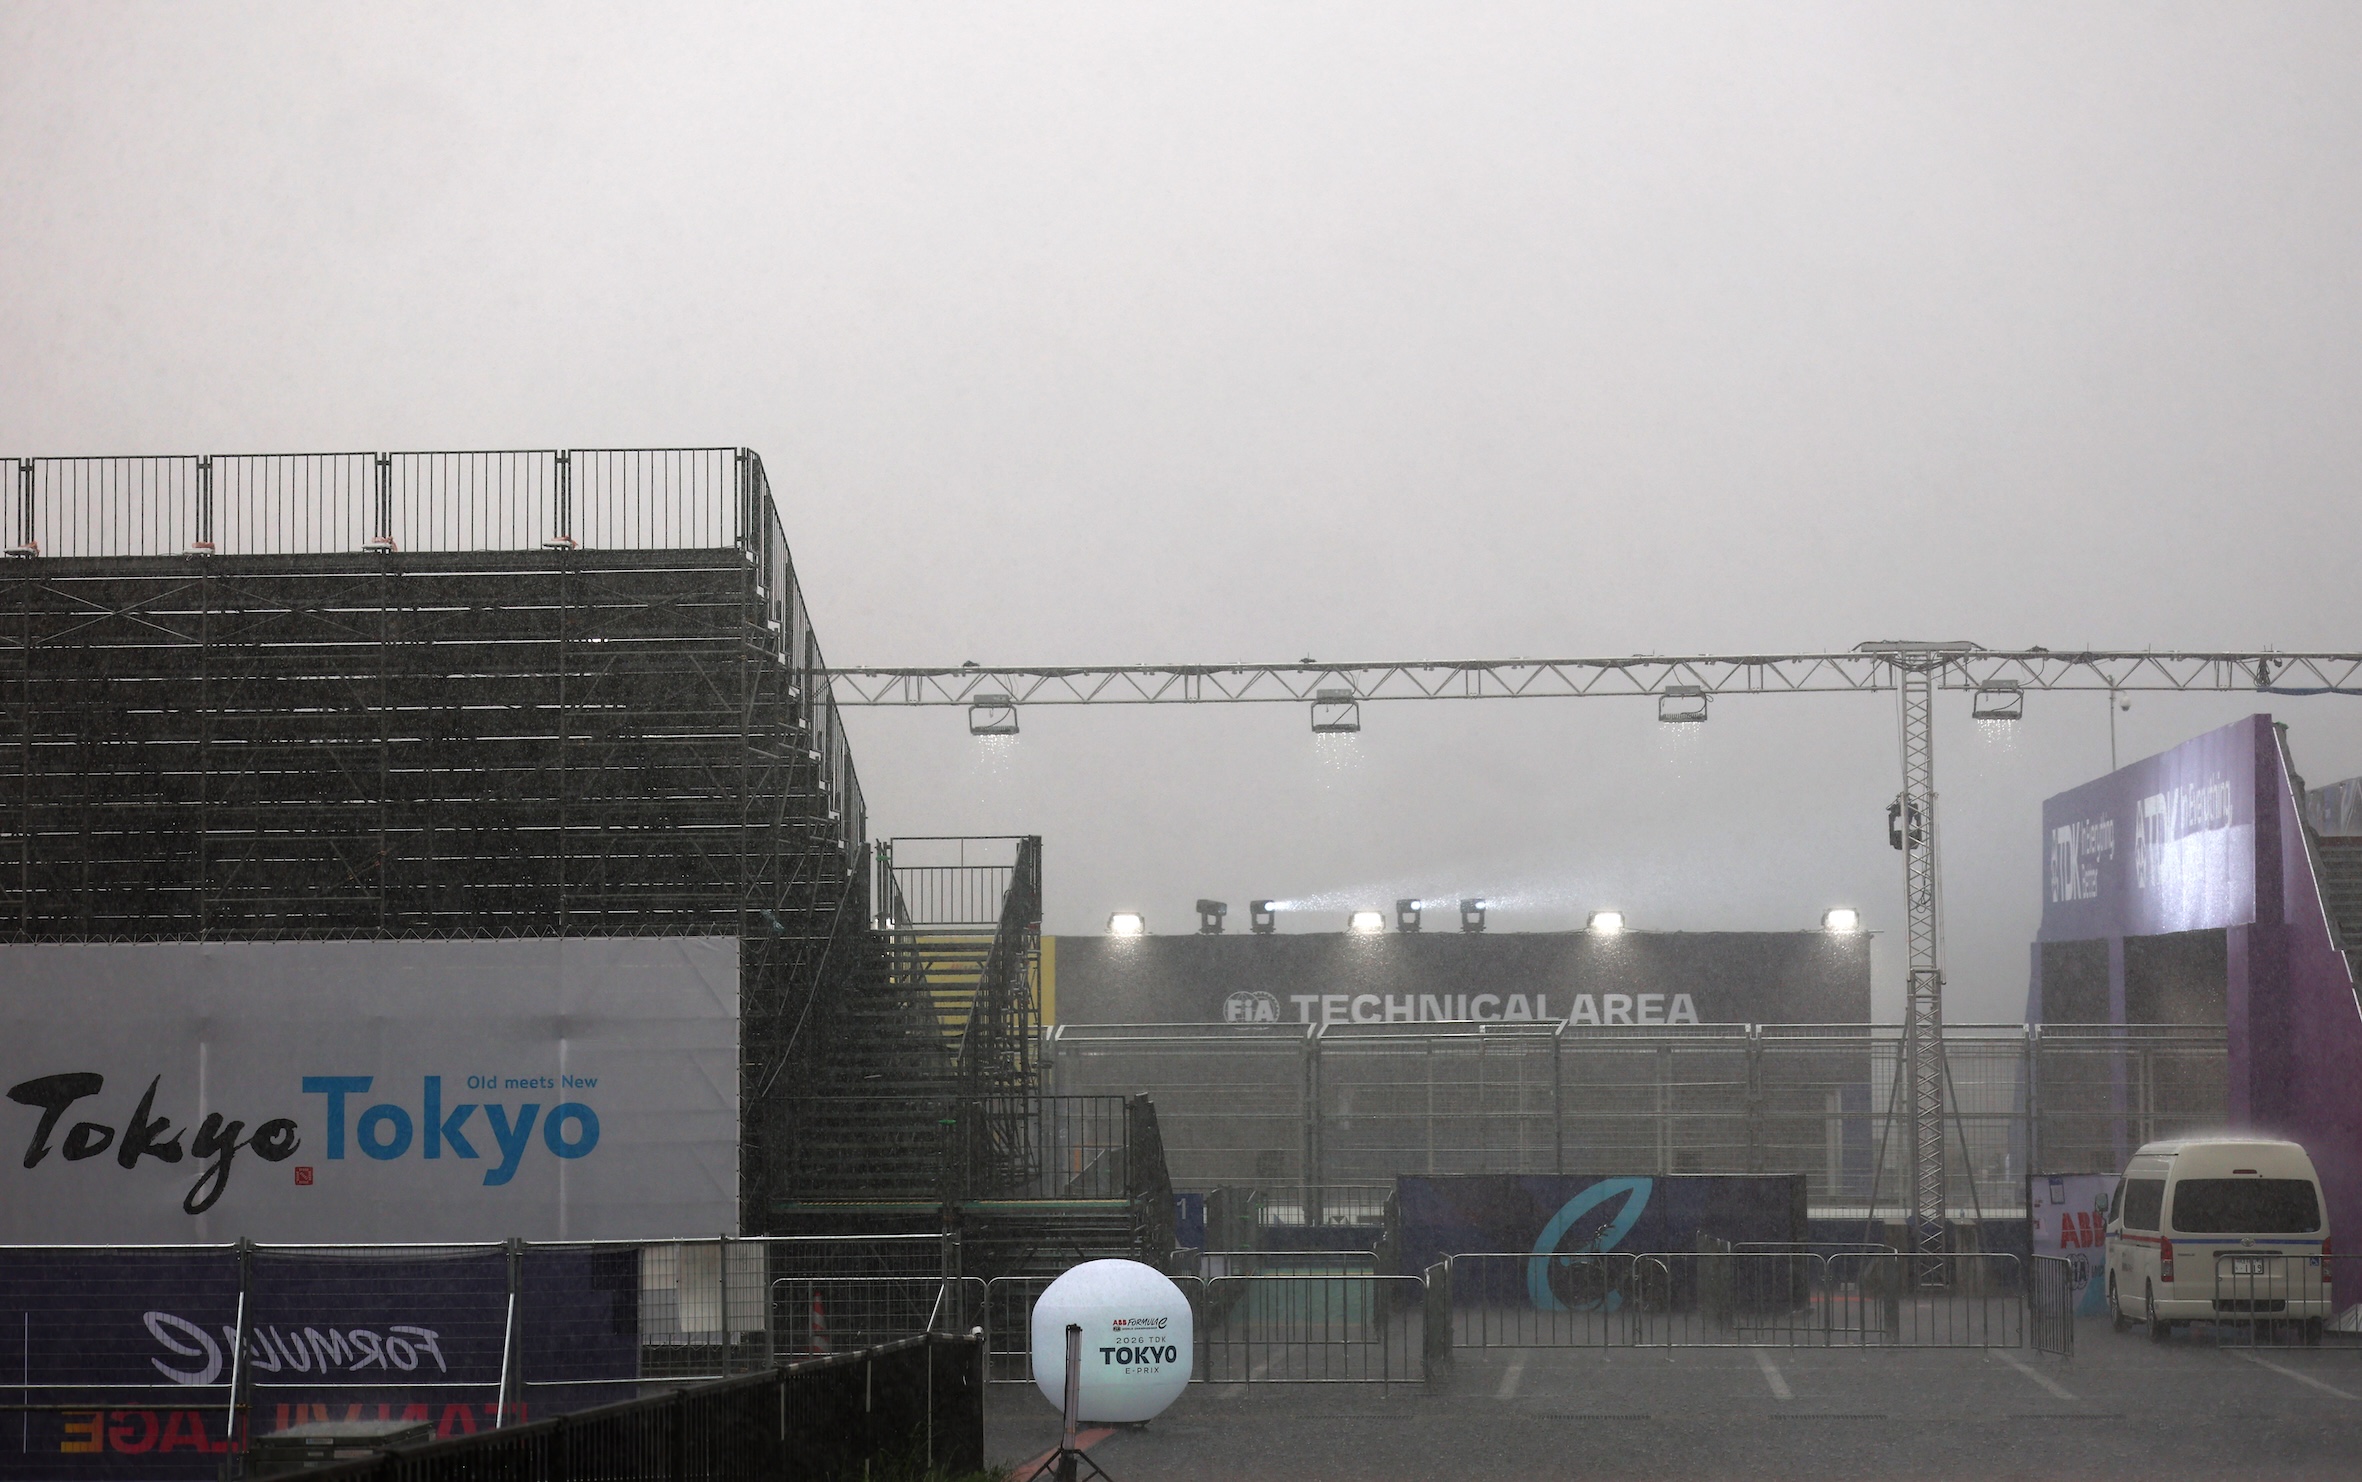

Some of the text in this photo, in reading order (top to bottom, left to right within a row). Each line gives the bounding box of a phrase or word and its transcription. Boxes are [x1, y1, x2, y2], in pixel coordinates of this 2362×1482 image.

[2057, 821, 2083, 902] TDK
[1290, 994, 1561, 1024] TECHNICAL
[1567, 993, 1700, 1025] AREA
[467, 1075, 598, 1090] Old meets New
[6, 1072, 600, 1215] Tokyo Tokyo
[2061, 1211, 2106, 1249] ABB
[1127, 1317, 1159, 1327] FORMULA
[1116, 1336, 1144, 1344] 2026
[1099, 1345, 1177, 1365] TOKYO
[1125, 1366, 1160, 1374] E-PRIX
